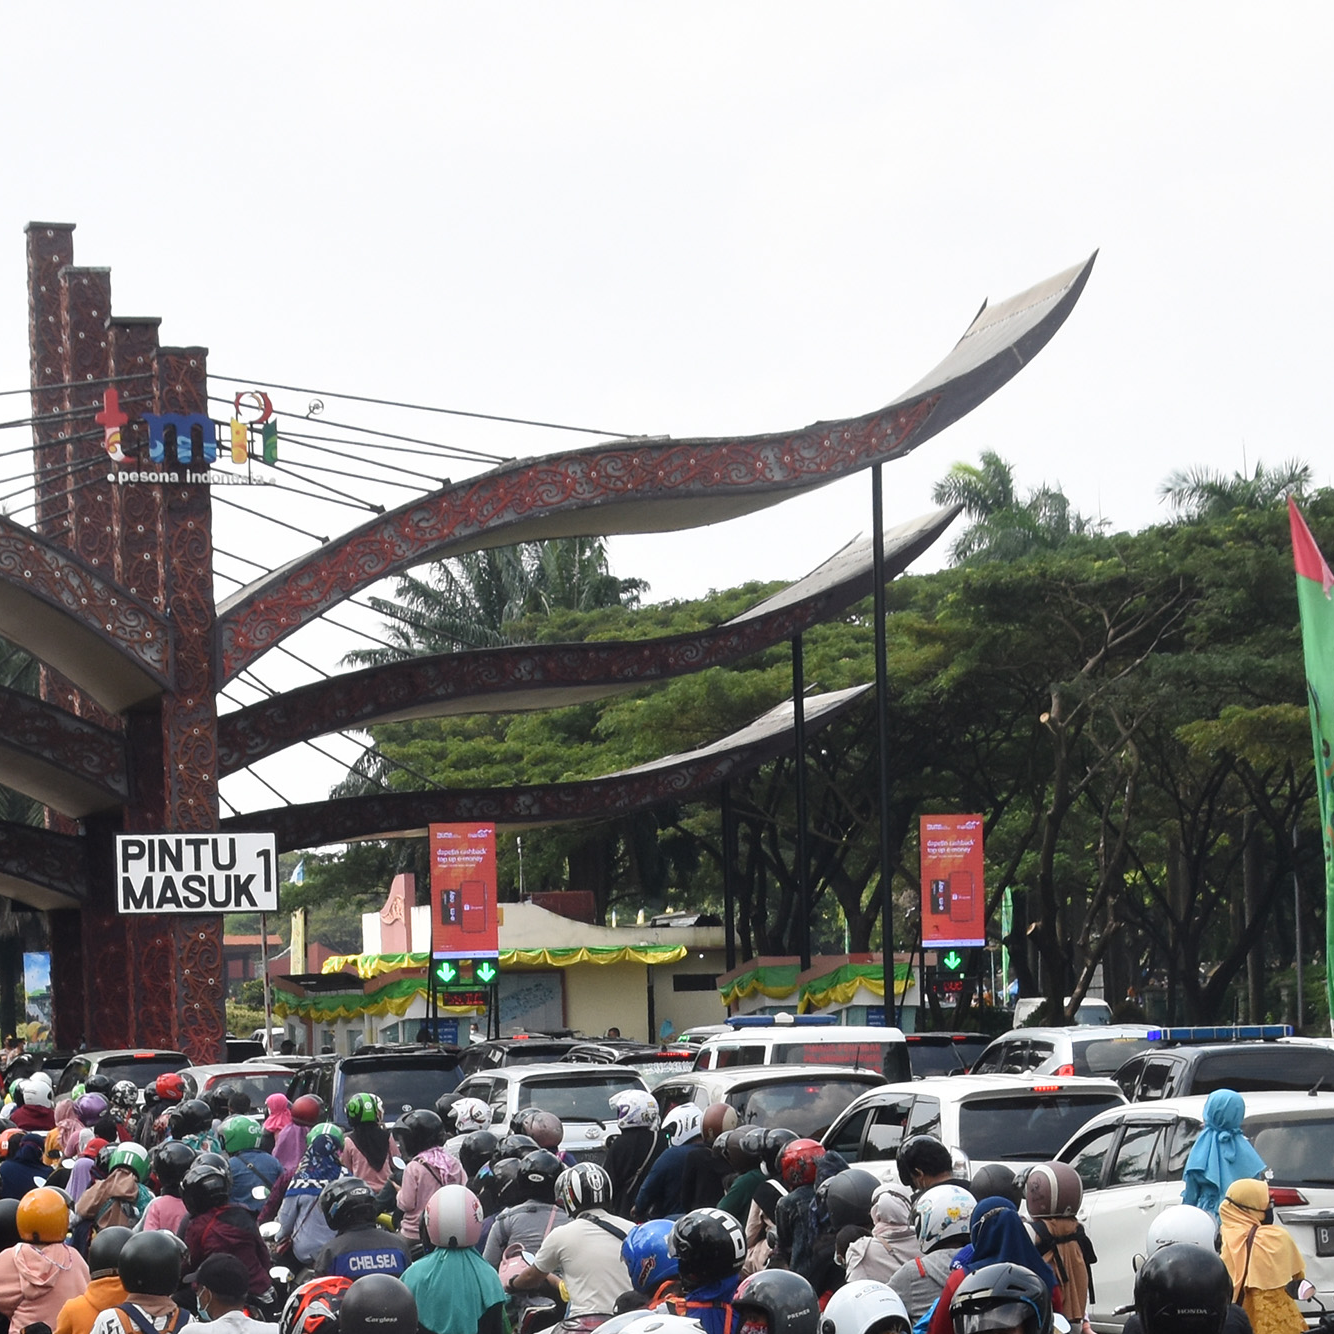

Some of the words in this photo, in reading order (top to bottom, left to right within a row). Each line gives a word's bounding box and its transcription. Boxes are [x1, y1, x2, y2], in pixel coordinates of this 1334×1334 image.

[95, 387, 278, 465] tmii
[118, 470, 179, 484] pesona
[121, 837, 237, 873] PINTU
[256, 848, 271, 892] 1
[121, 873, 258, 909] MASUK
[1321, 1229, 1329, 1243] B
[349, 1254, 398, 1271] CHELSEA
